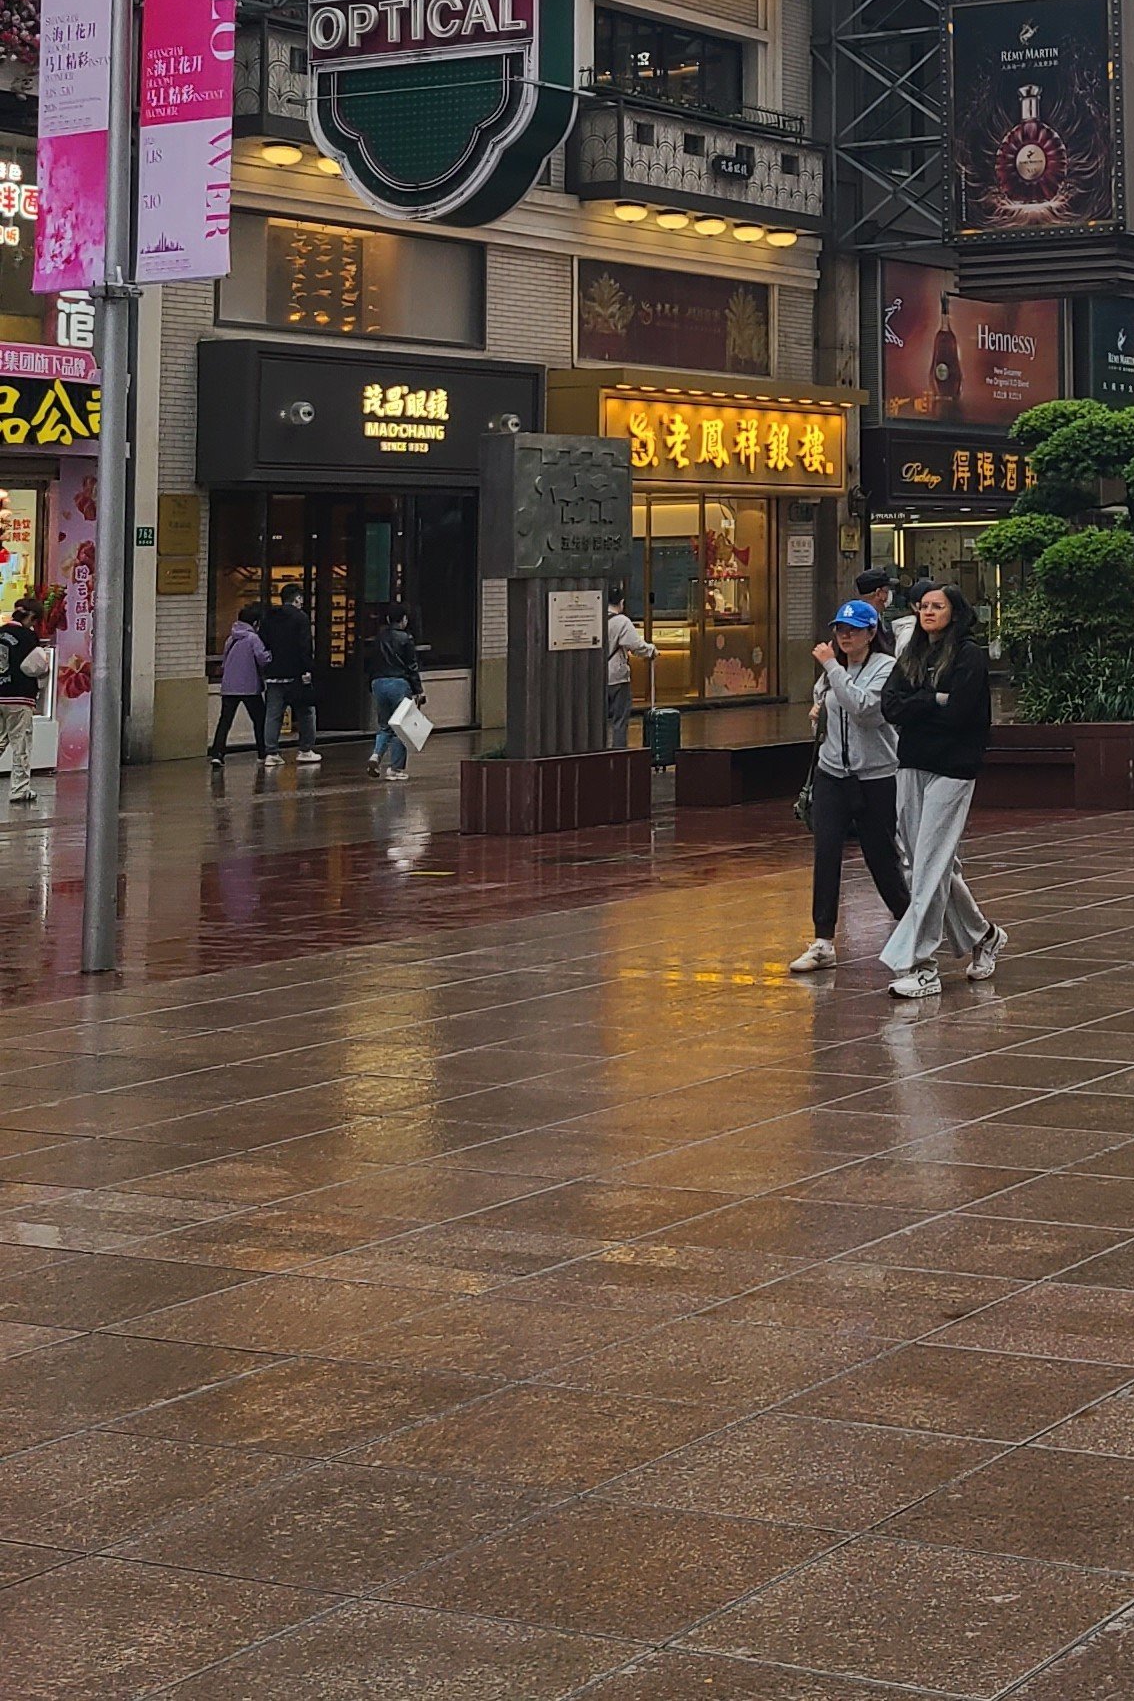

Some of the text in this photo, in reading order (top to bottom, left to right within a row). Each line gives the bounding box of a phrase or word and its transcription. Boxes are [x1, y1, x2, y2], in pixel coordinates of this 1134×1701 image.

[154, 55, 203, 77] 海上花开
[1025, 47, 1059, 60] MARTIN
[147, 84, 195, 108] 马上精彩
[57, 300, 96, 347] 馆
[977, 323, 1037, 361] Hennessy
[0, 349, 87, 379] 集团旗下品牌
[362, 383, 450, 421] 茂昌眼镜
[364, 421, 446, 441] MAOCHANG
[665, 413, 826, 475] 老鳳祥銀樓
[380, 441, 408, 452] SINCE
